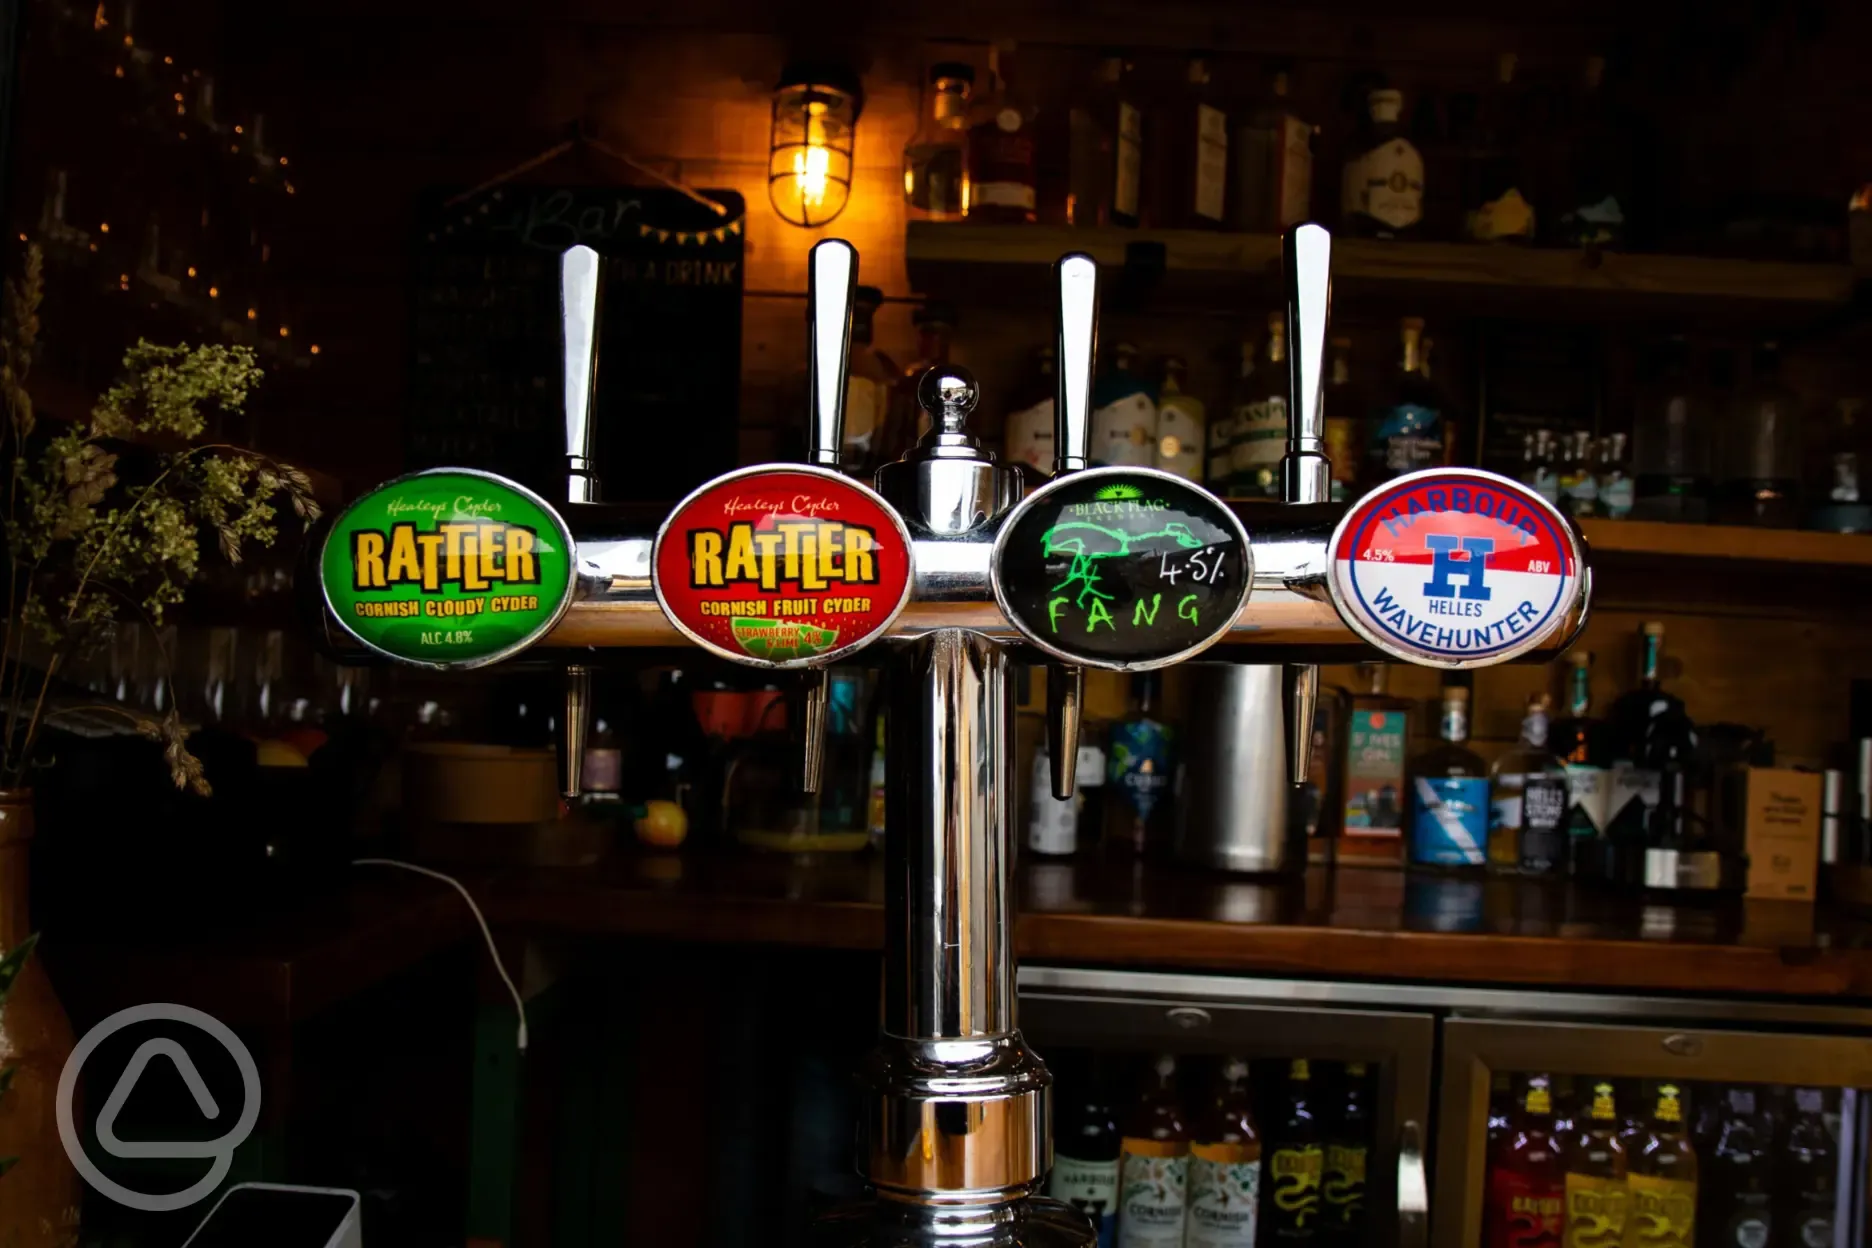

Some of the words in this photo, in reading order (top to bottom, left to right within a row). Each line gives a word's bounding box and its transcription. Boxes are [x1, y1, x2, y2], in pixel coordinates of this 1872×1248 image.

[521, 189, 642, 249] Bar
[664, 259, 737, 287] DRINK
[453, 496, 503, 518] Cyder
[791, 495, 840, 518] Cyder
[1075, 501, 1126, 516] BLACK
[1129, 498, 1166, 512] FLAG
[1380, 487, 1539, 546] HARBOUR
[354, 522, 538, 592] RATTLER
[692, 522, 876, 591] RATTLER
[1159, 546, 1226, 586] 4.5%
[1363, 549, 1396, 562] 4.5%
[1527, 560, 1551, 573] ABV
[355, 600, 420, 617] CORNISH
[425, 597, 485, 617] CLOUDY
[490, 596, 538, 613] CYDER
[700, 600, 767, 617] CORNISH
[773, 599, 818, 616] FRUIT
[823, 598, 872, 614] CYDER
[1429, 600, 1483, 618] HELLES
[1373, 586, 1540, 649] WAVEHUNTER
[421, 631, 443, 645] ALC
[444, 630, 473, 645] 4.8%
[735, 627, 799, 639] STRAWBERRY
[775, 638, 799, 648] LIME
[803, 631, 823, 645] 4%
